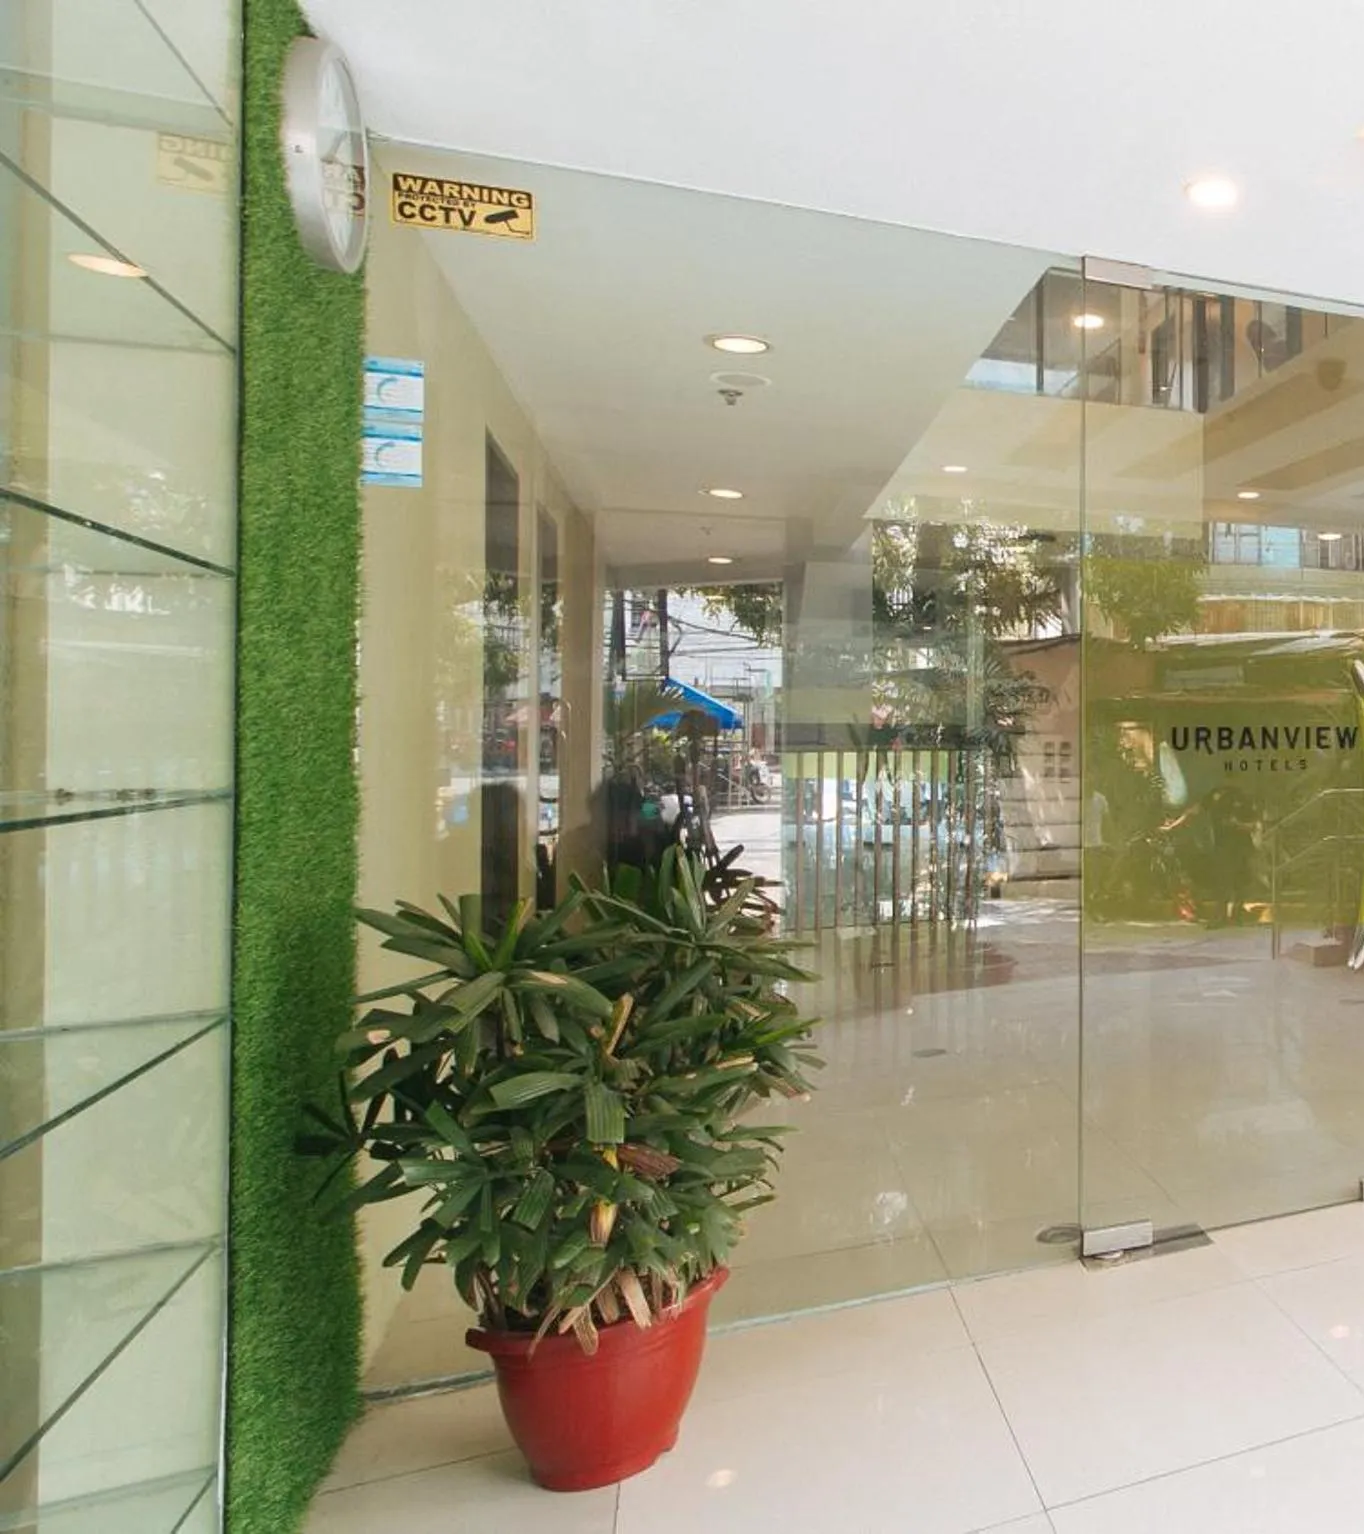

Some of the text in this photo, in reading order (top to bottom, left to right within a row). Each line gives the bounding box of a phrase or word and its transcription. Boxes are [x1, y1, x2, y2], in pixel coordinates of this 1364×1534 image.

[398, 176, 530, 207] WARNING
[399, 191, 476, 208] PROTECTED BY
[399, 201, 476, 227] CCTV
[1171, 726, 1359, 755] URBANVIEW
[1224, 759, 1307, 772] HOTELS
